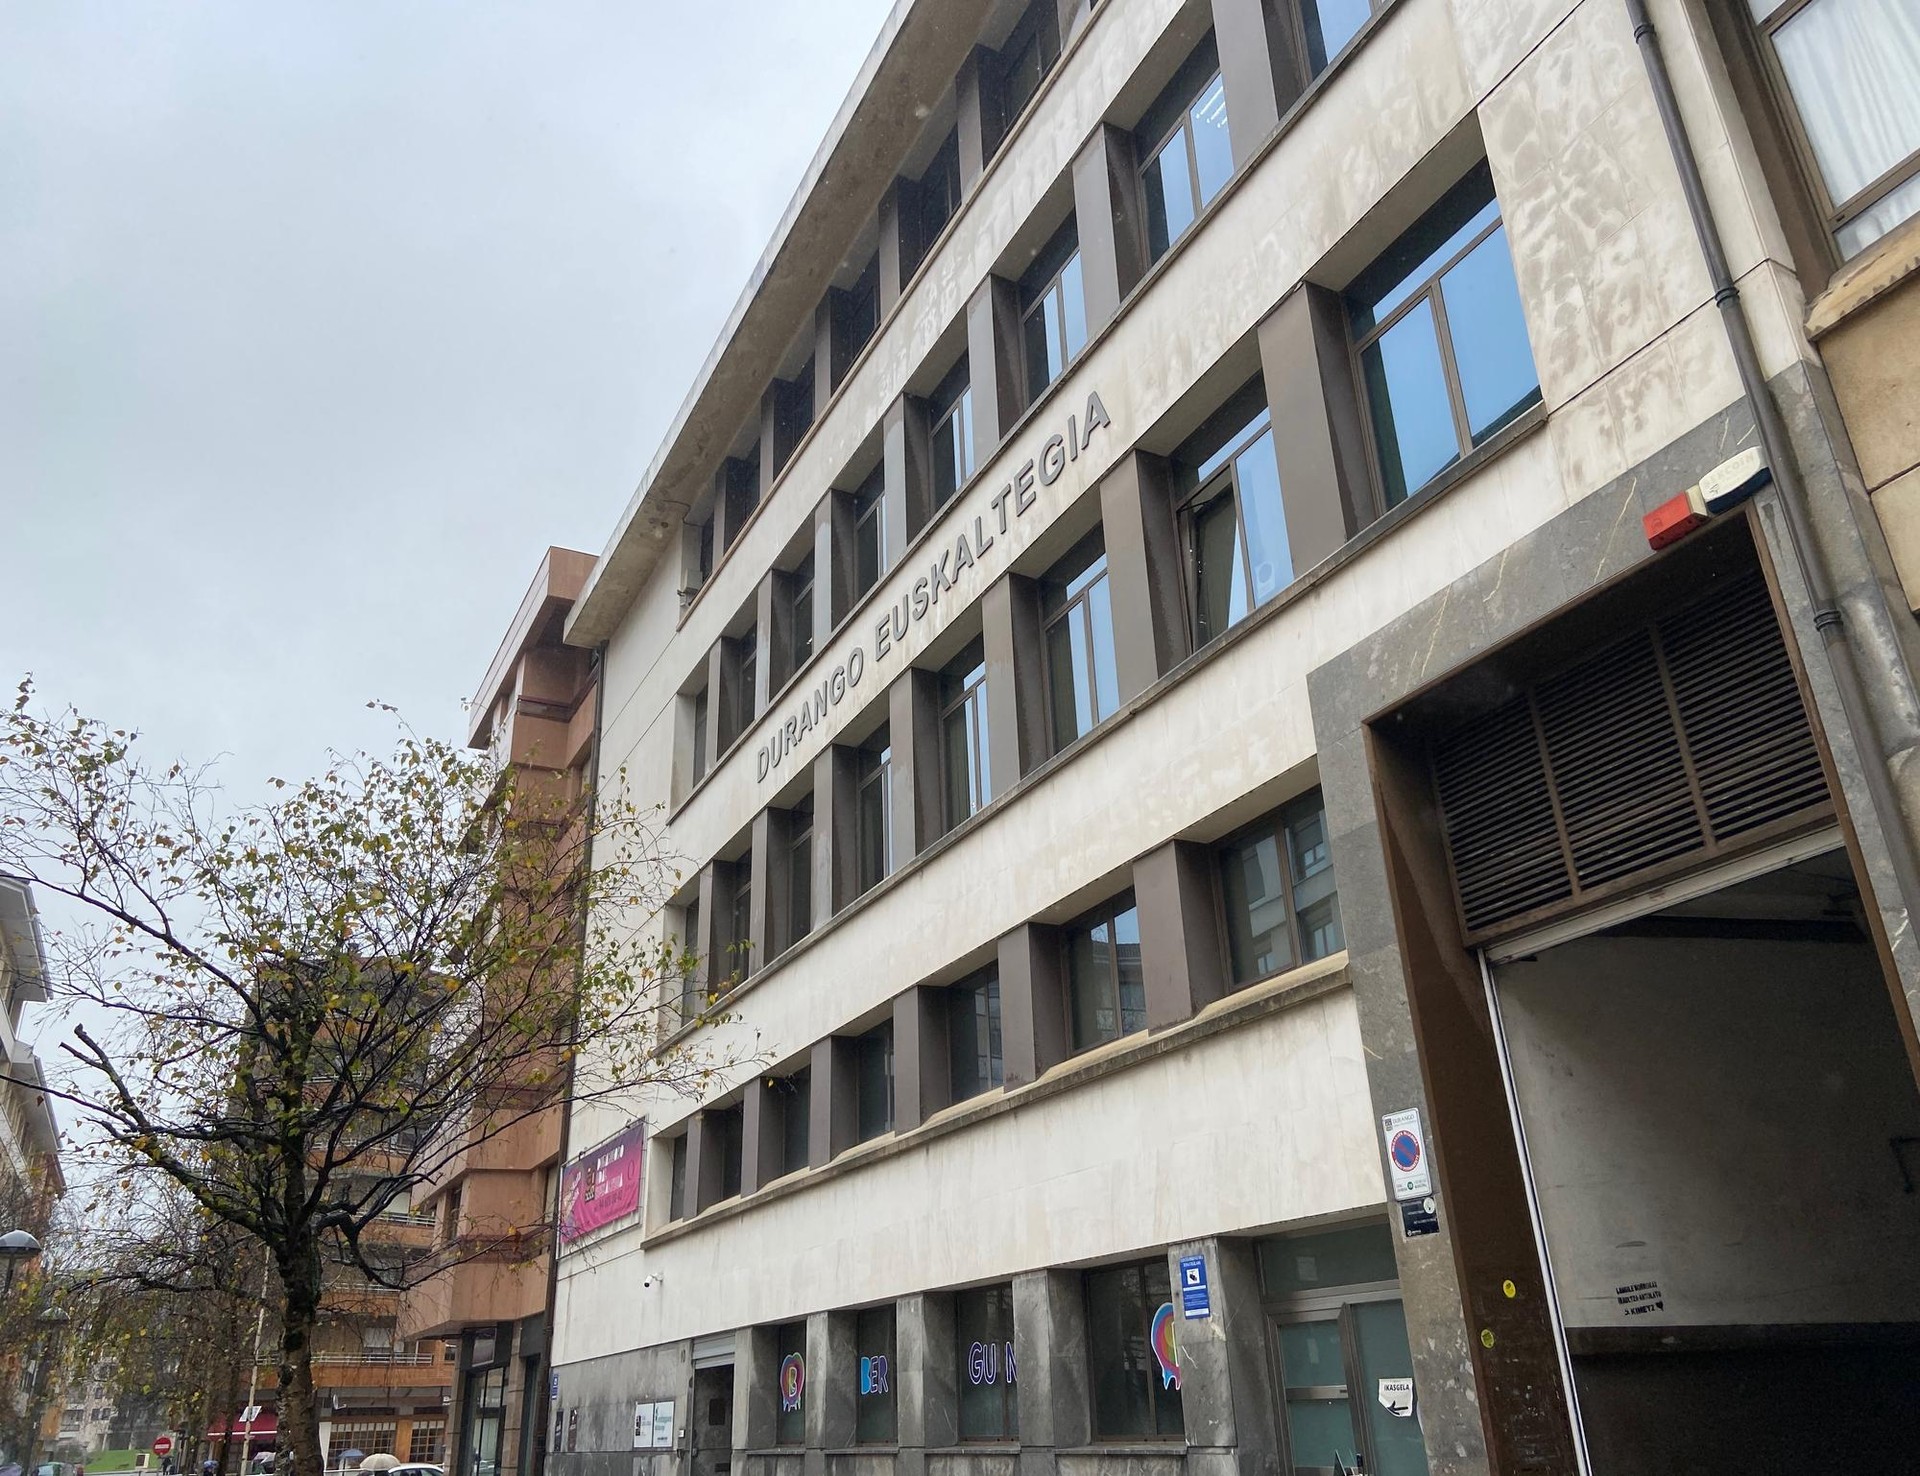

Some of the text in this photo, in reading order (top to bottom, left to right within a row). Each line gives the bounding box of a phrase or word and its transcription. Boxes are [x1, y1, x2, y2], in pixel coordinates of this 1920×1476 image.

[756, 390, 1111, 784] DURANGO EUSKALTEGIA
[860, 1355, 889, 1395] BER
